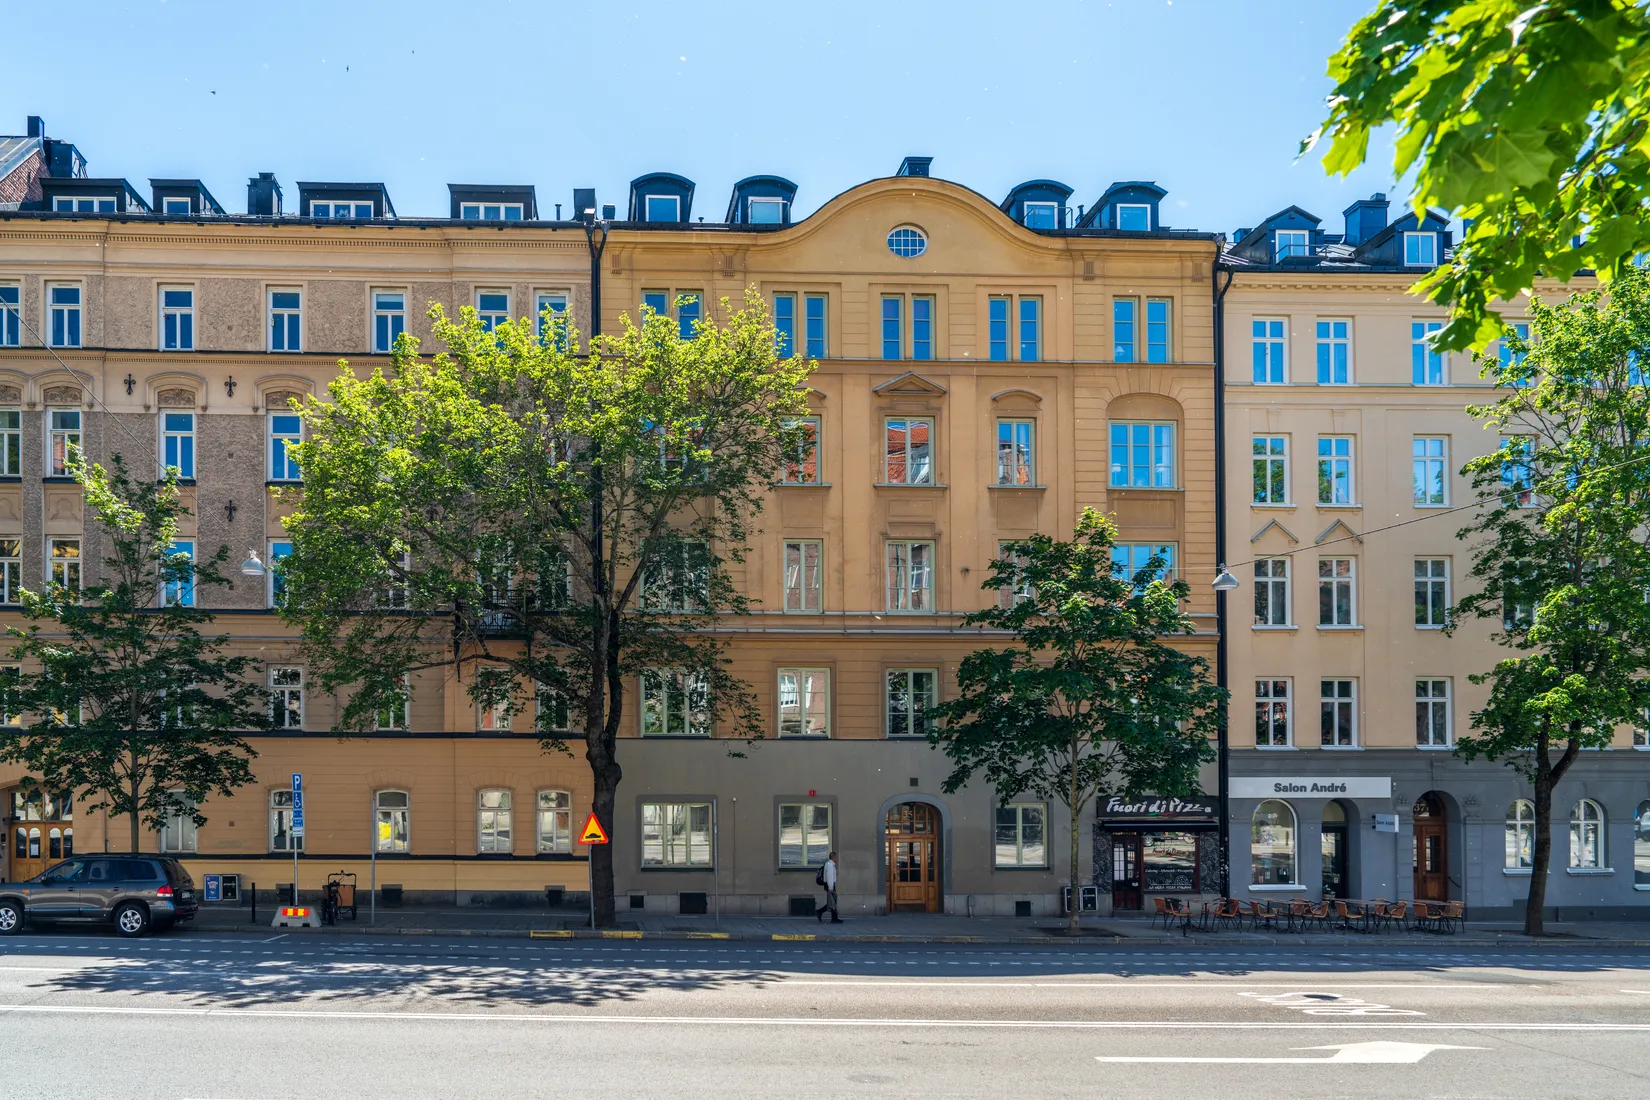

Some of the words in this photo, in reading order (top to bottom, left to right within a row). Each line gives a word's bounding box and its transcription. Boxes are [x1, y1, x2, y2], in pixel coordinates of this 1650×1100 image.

[294, 775, 301, 790] P
[1274, 782, 1307, 793] Salon
[1310, 782, 1347, 793] André
[1106, 797, 1148, 813] Fuori
[1148, 800, 1167, 813] di
